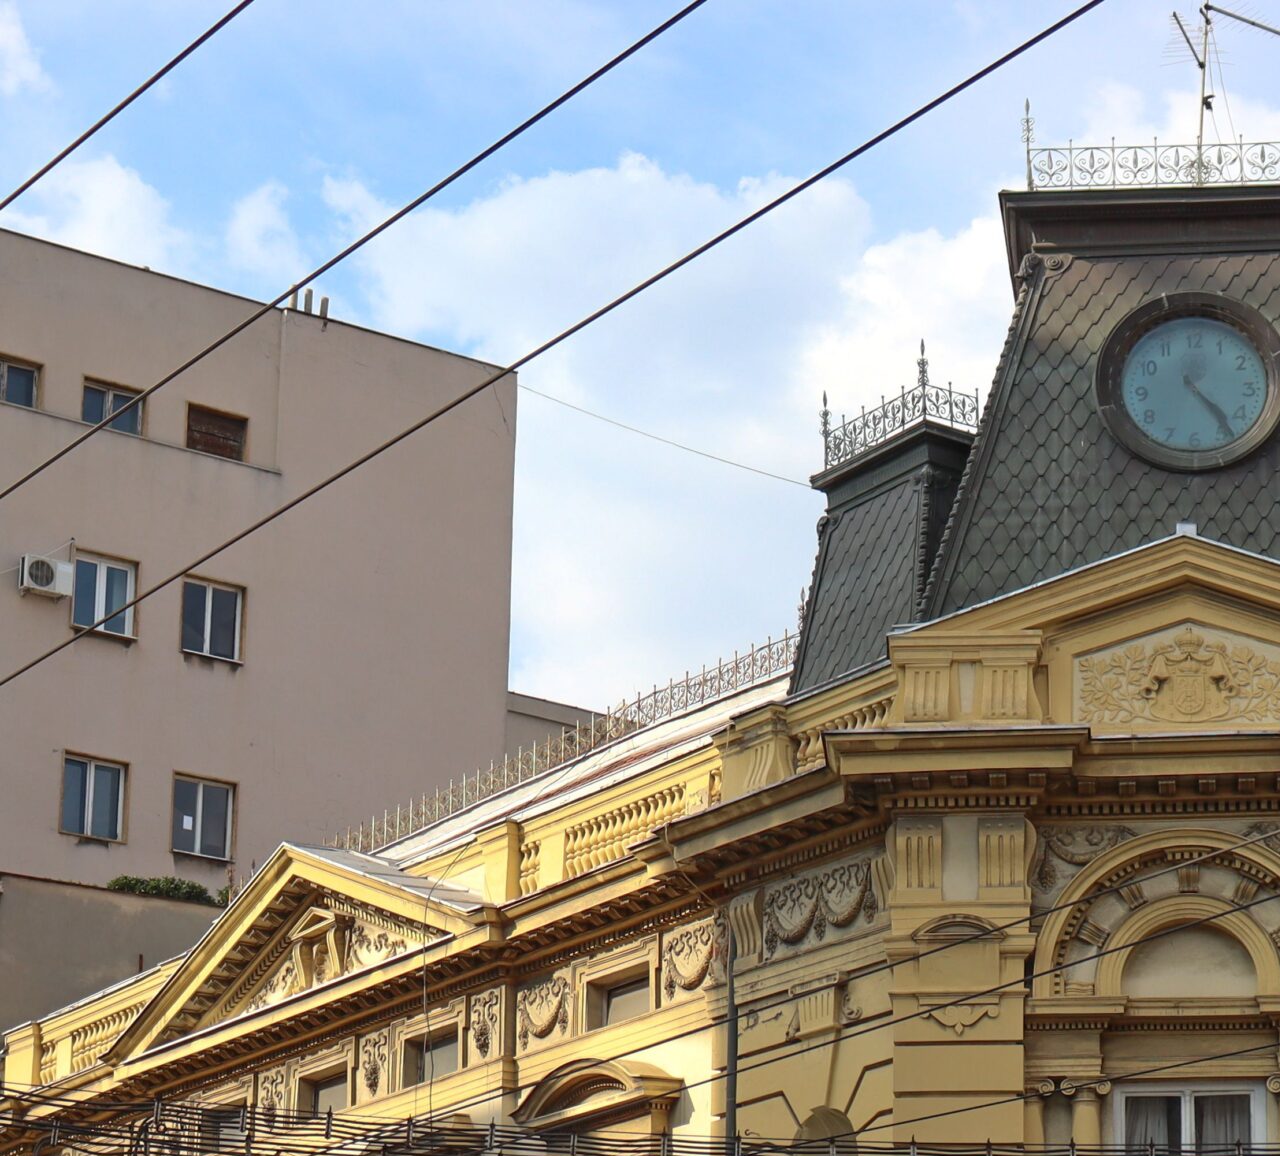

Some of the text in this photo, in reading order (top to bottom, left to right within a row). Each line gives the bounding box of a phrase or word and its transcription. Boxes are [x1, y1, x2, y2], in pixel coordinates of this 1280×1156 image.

[1161, 341, 1171, 357] 11
[1186, 333, 1203, 349] 12
[1216, 340, 1223, 355] 1
[1142, 360, 1157, 376] 10
[1235, 355, 1247, 371] 2
[1135, 386, 1148, 401] 9
[1242, 382, 1256, 397] 3
[1143, 409, 1155, 424] 8
[1232, 405, 1247, 421] 4
[1165, 428, 1176, 442] 7
[1188, 432, 1200, 448] 6
